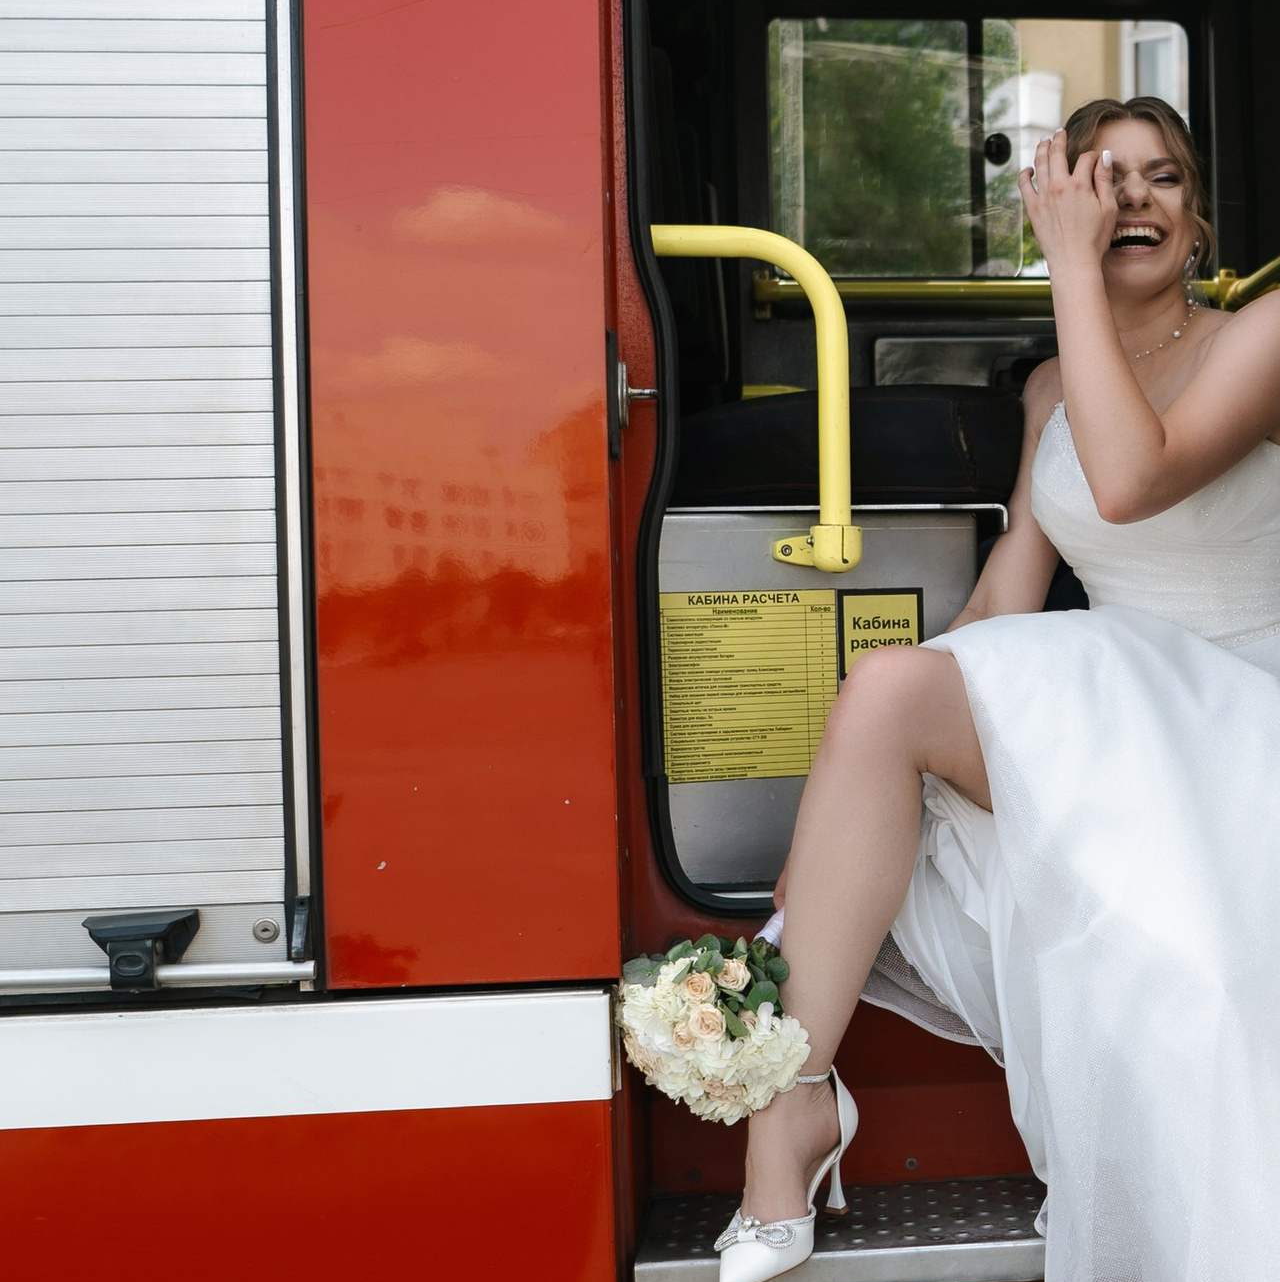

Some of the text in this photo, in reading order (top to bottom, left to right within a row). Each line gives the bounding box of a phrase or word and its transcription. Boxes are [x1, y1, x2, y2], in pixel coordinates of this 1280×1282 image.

[687, 593, 800, 606] КАБИНА РАСЧЕТА
[810, 605, 832, 613] Кол-во
[852, 616, 911, 631] Кабина
[850, 637, 914, 652] расчета
